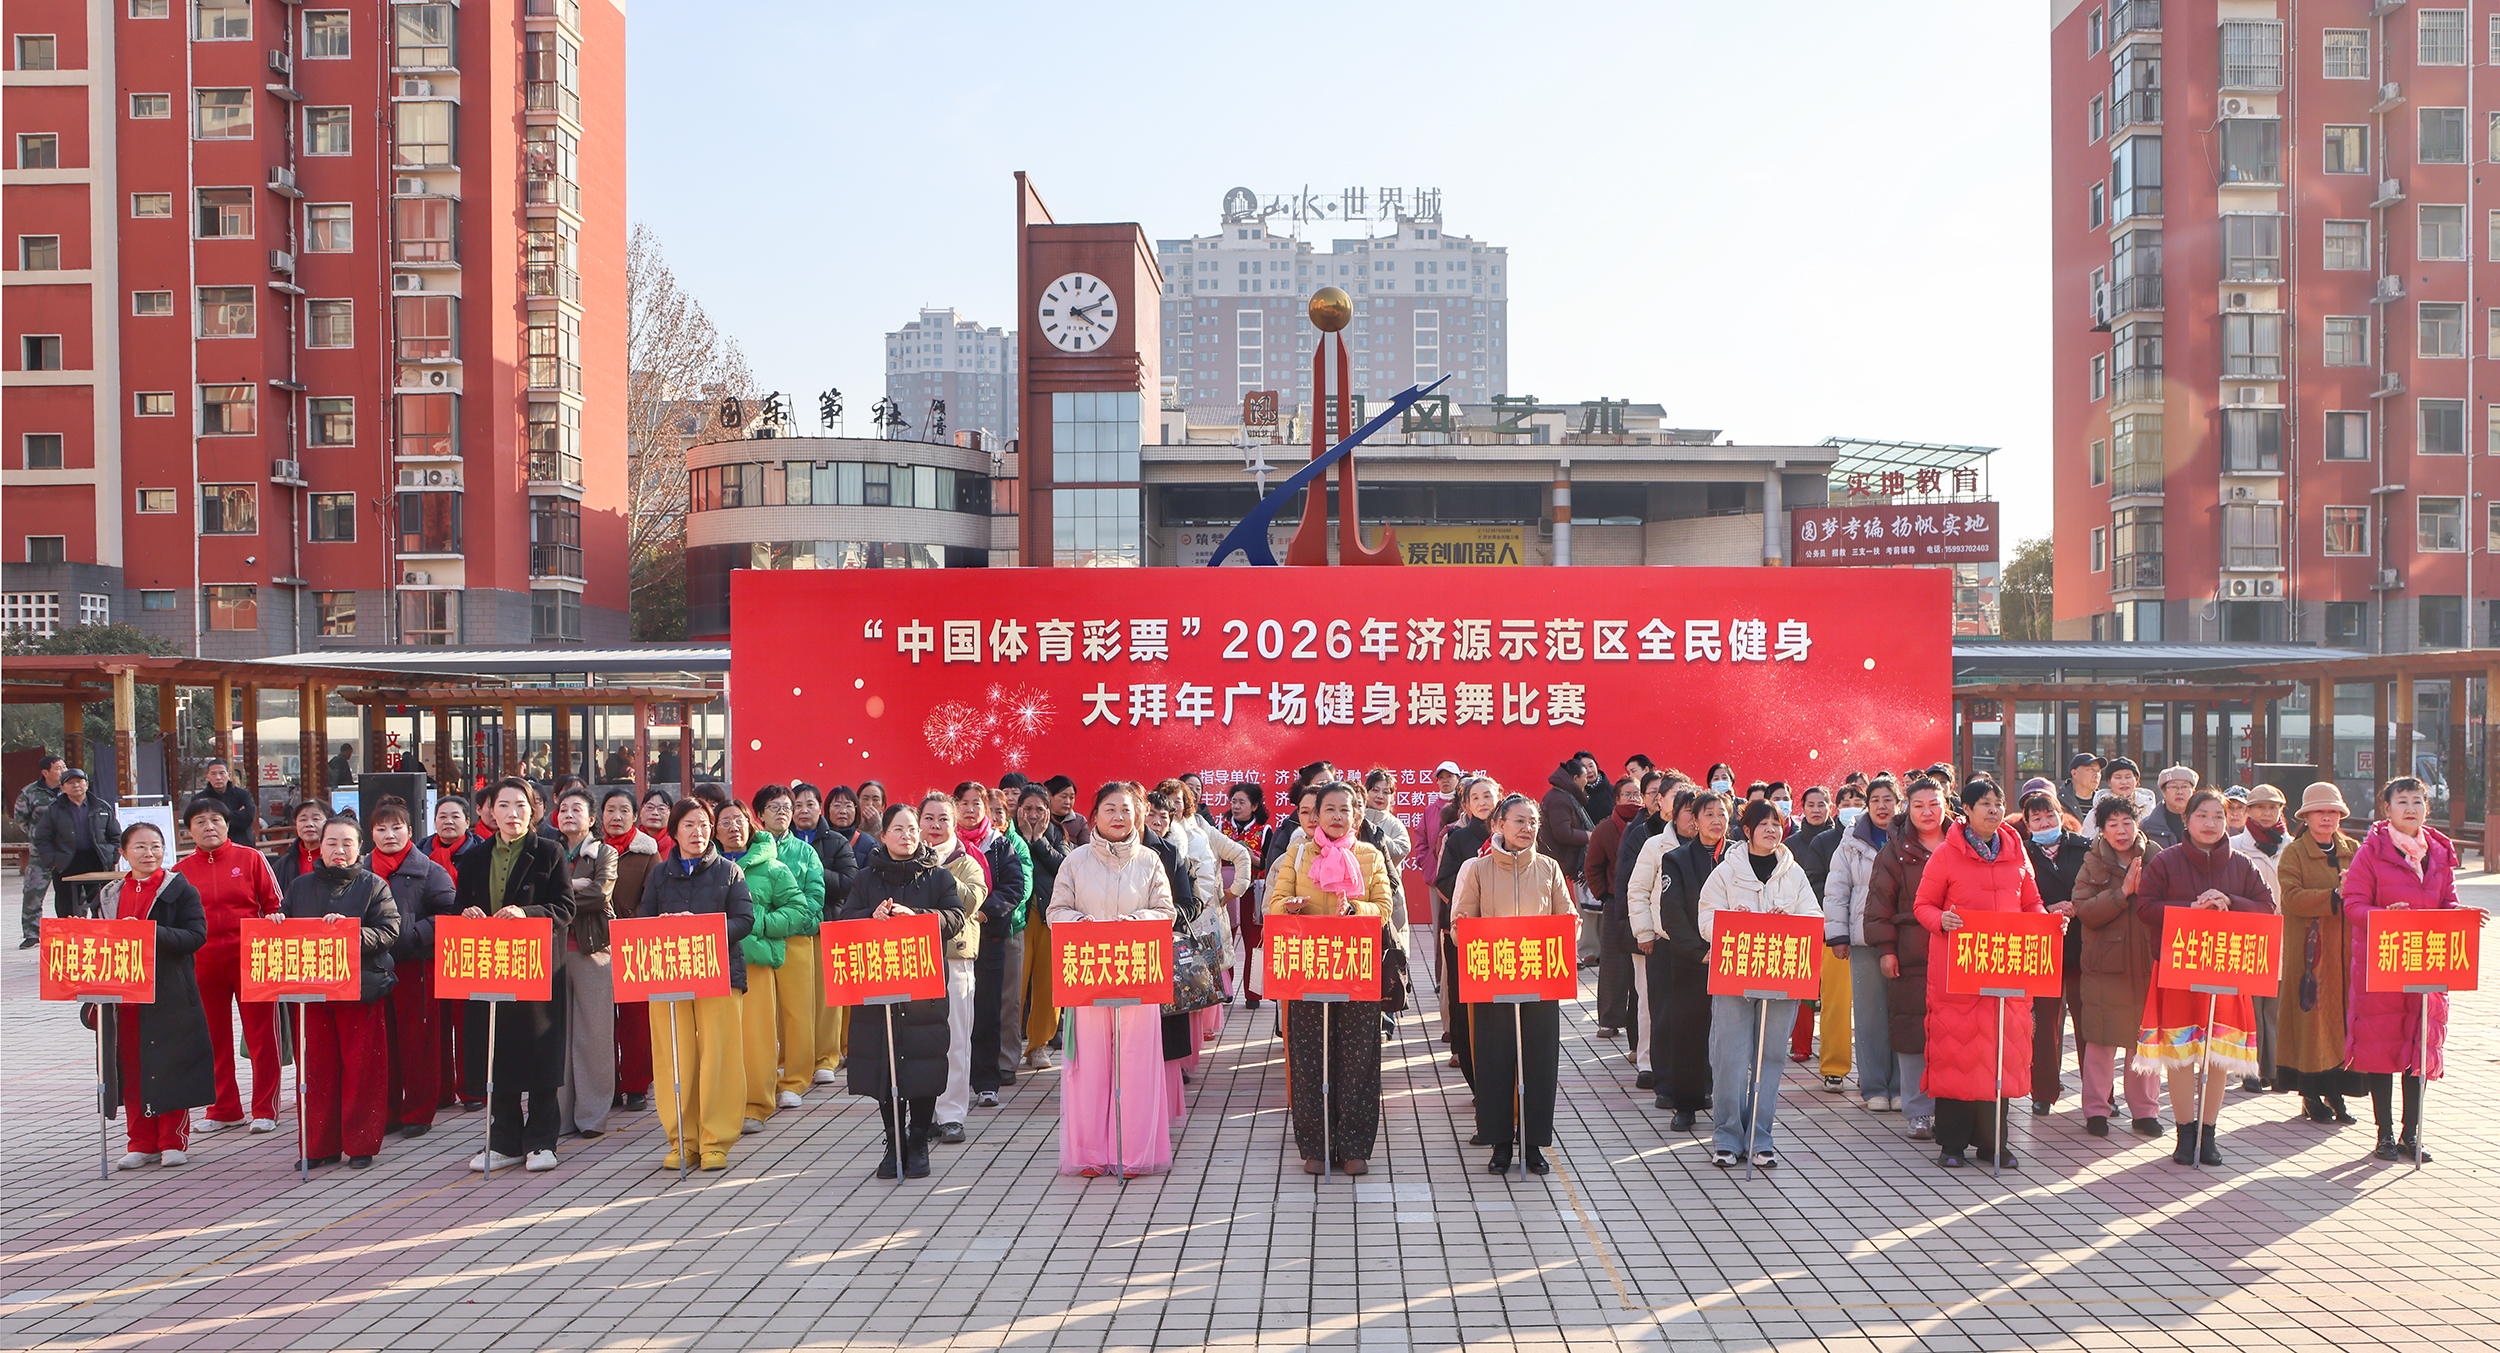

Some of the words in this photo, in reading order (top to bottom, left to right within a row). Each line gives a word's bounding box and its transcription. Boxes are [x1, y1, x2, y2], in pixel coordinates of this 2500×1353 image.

[1847, 466, 1979, 499] 实地教育
[1801, 515, 1884, 543] 圆梦考编
[1890, 513, 1990, 538] 扬帆实地
[1408, 542, 1519, 565] 爱创机器人
[1805, 549, 1826, 559] 公务员
[1885, 545, 1916, 556] 考前辅导
[1081, 681, 1587, 731] 大拜年广场健身操舞比赛
[262, 763, 280, 781] 幸
[49, 937, 147, 984] 闪电柔力球队
[443, 936, 545, 981] 沁园春舞蹈队
[621, 934, 719, 984] 文化城东舞蹈队
[830, 934, 937, 985] 东郭路舞蹈队
[1062, 939, 1164, 987] 泰宏天安舞队
[1272, 934, 1373, 981] 歌声嘹亮艺术团
[1466, 936, 1570, 982] 嗨嗨舞队
[1718, 930, 1812, 980] 东留养鼓舞队
[1956, 931, 2055, 976] 环保苑舞蹈队
[2171, 927, 2270, 976] 合生和景舞蹈队
[2377, 930, 2471, 973] 新疆舞队
